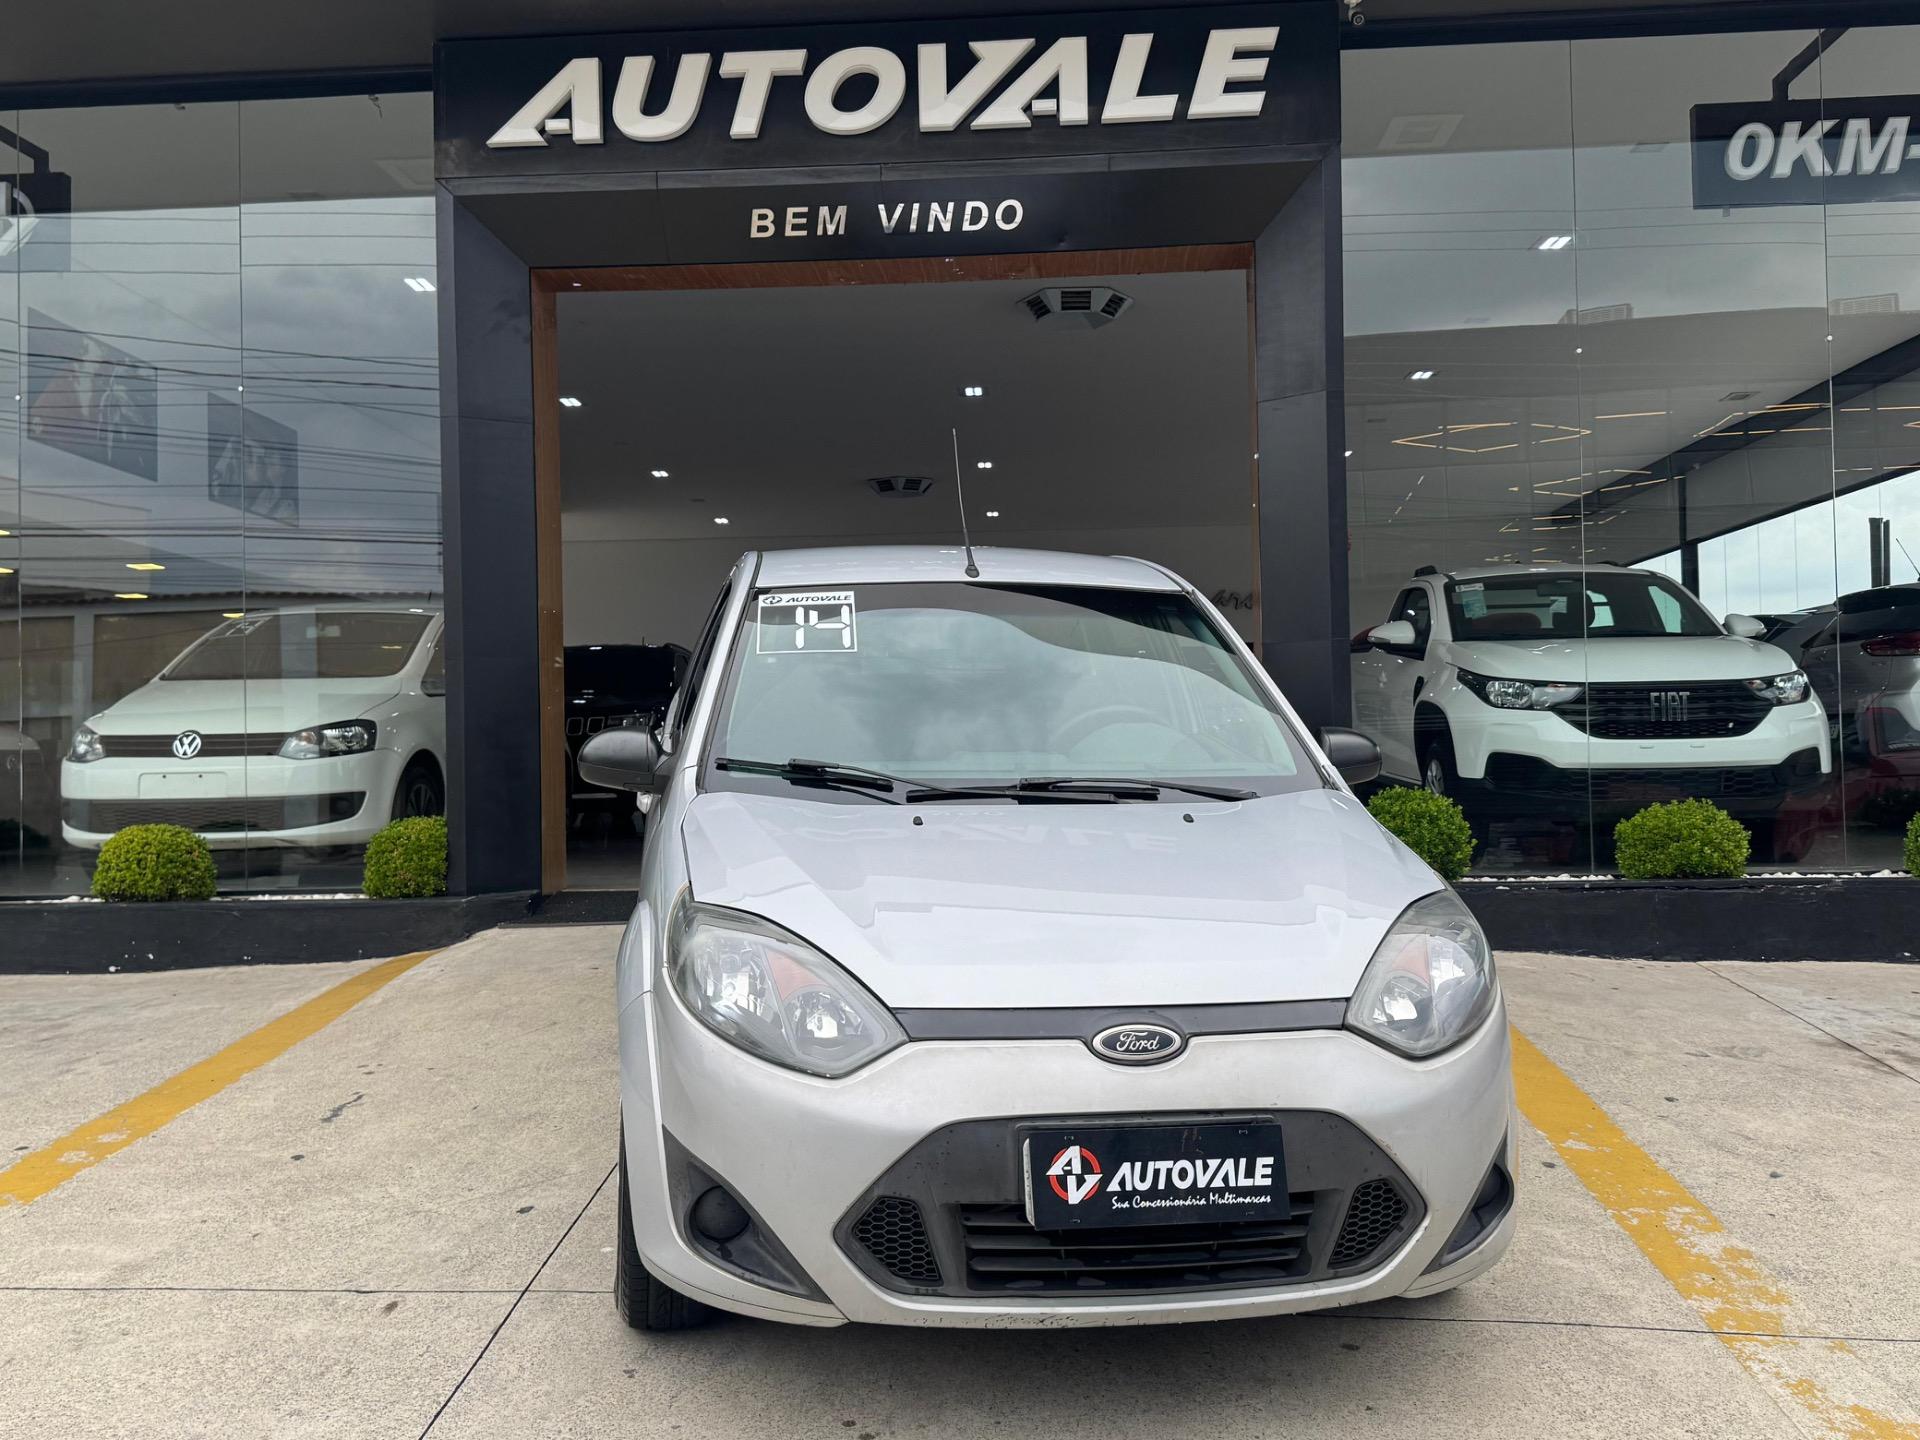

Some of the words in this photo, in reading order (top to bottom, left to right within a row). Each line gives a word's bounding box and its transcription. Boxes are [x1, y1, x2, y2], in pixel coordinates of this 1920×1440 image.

[486, 27, 1280, 149] AUTOVALE
[750, 205, 848, 239] BEM
[877, 199, 1024, 234] VINDO
[785, 594, 852, 604] AUTOVALE
[795, 604, 852, 649] 14
[1649, 691, 1690, 721] FIAT
[1116, 1031, 1160, 1051] Ford
[1106, 1156, 1275, 1192] AUTOVALE
[1112, 1196, 1130, 1209] Sua
[1133, 1195, 1206, 1208] Concessionária
[1209, 1192, 1272, 1204] Multimarcas
